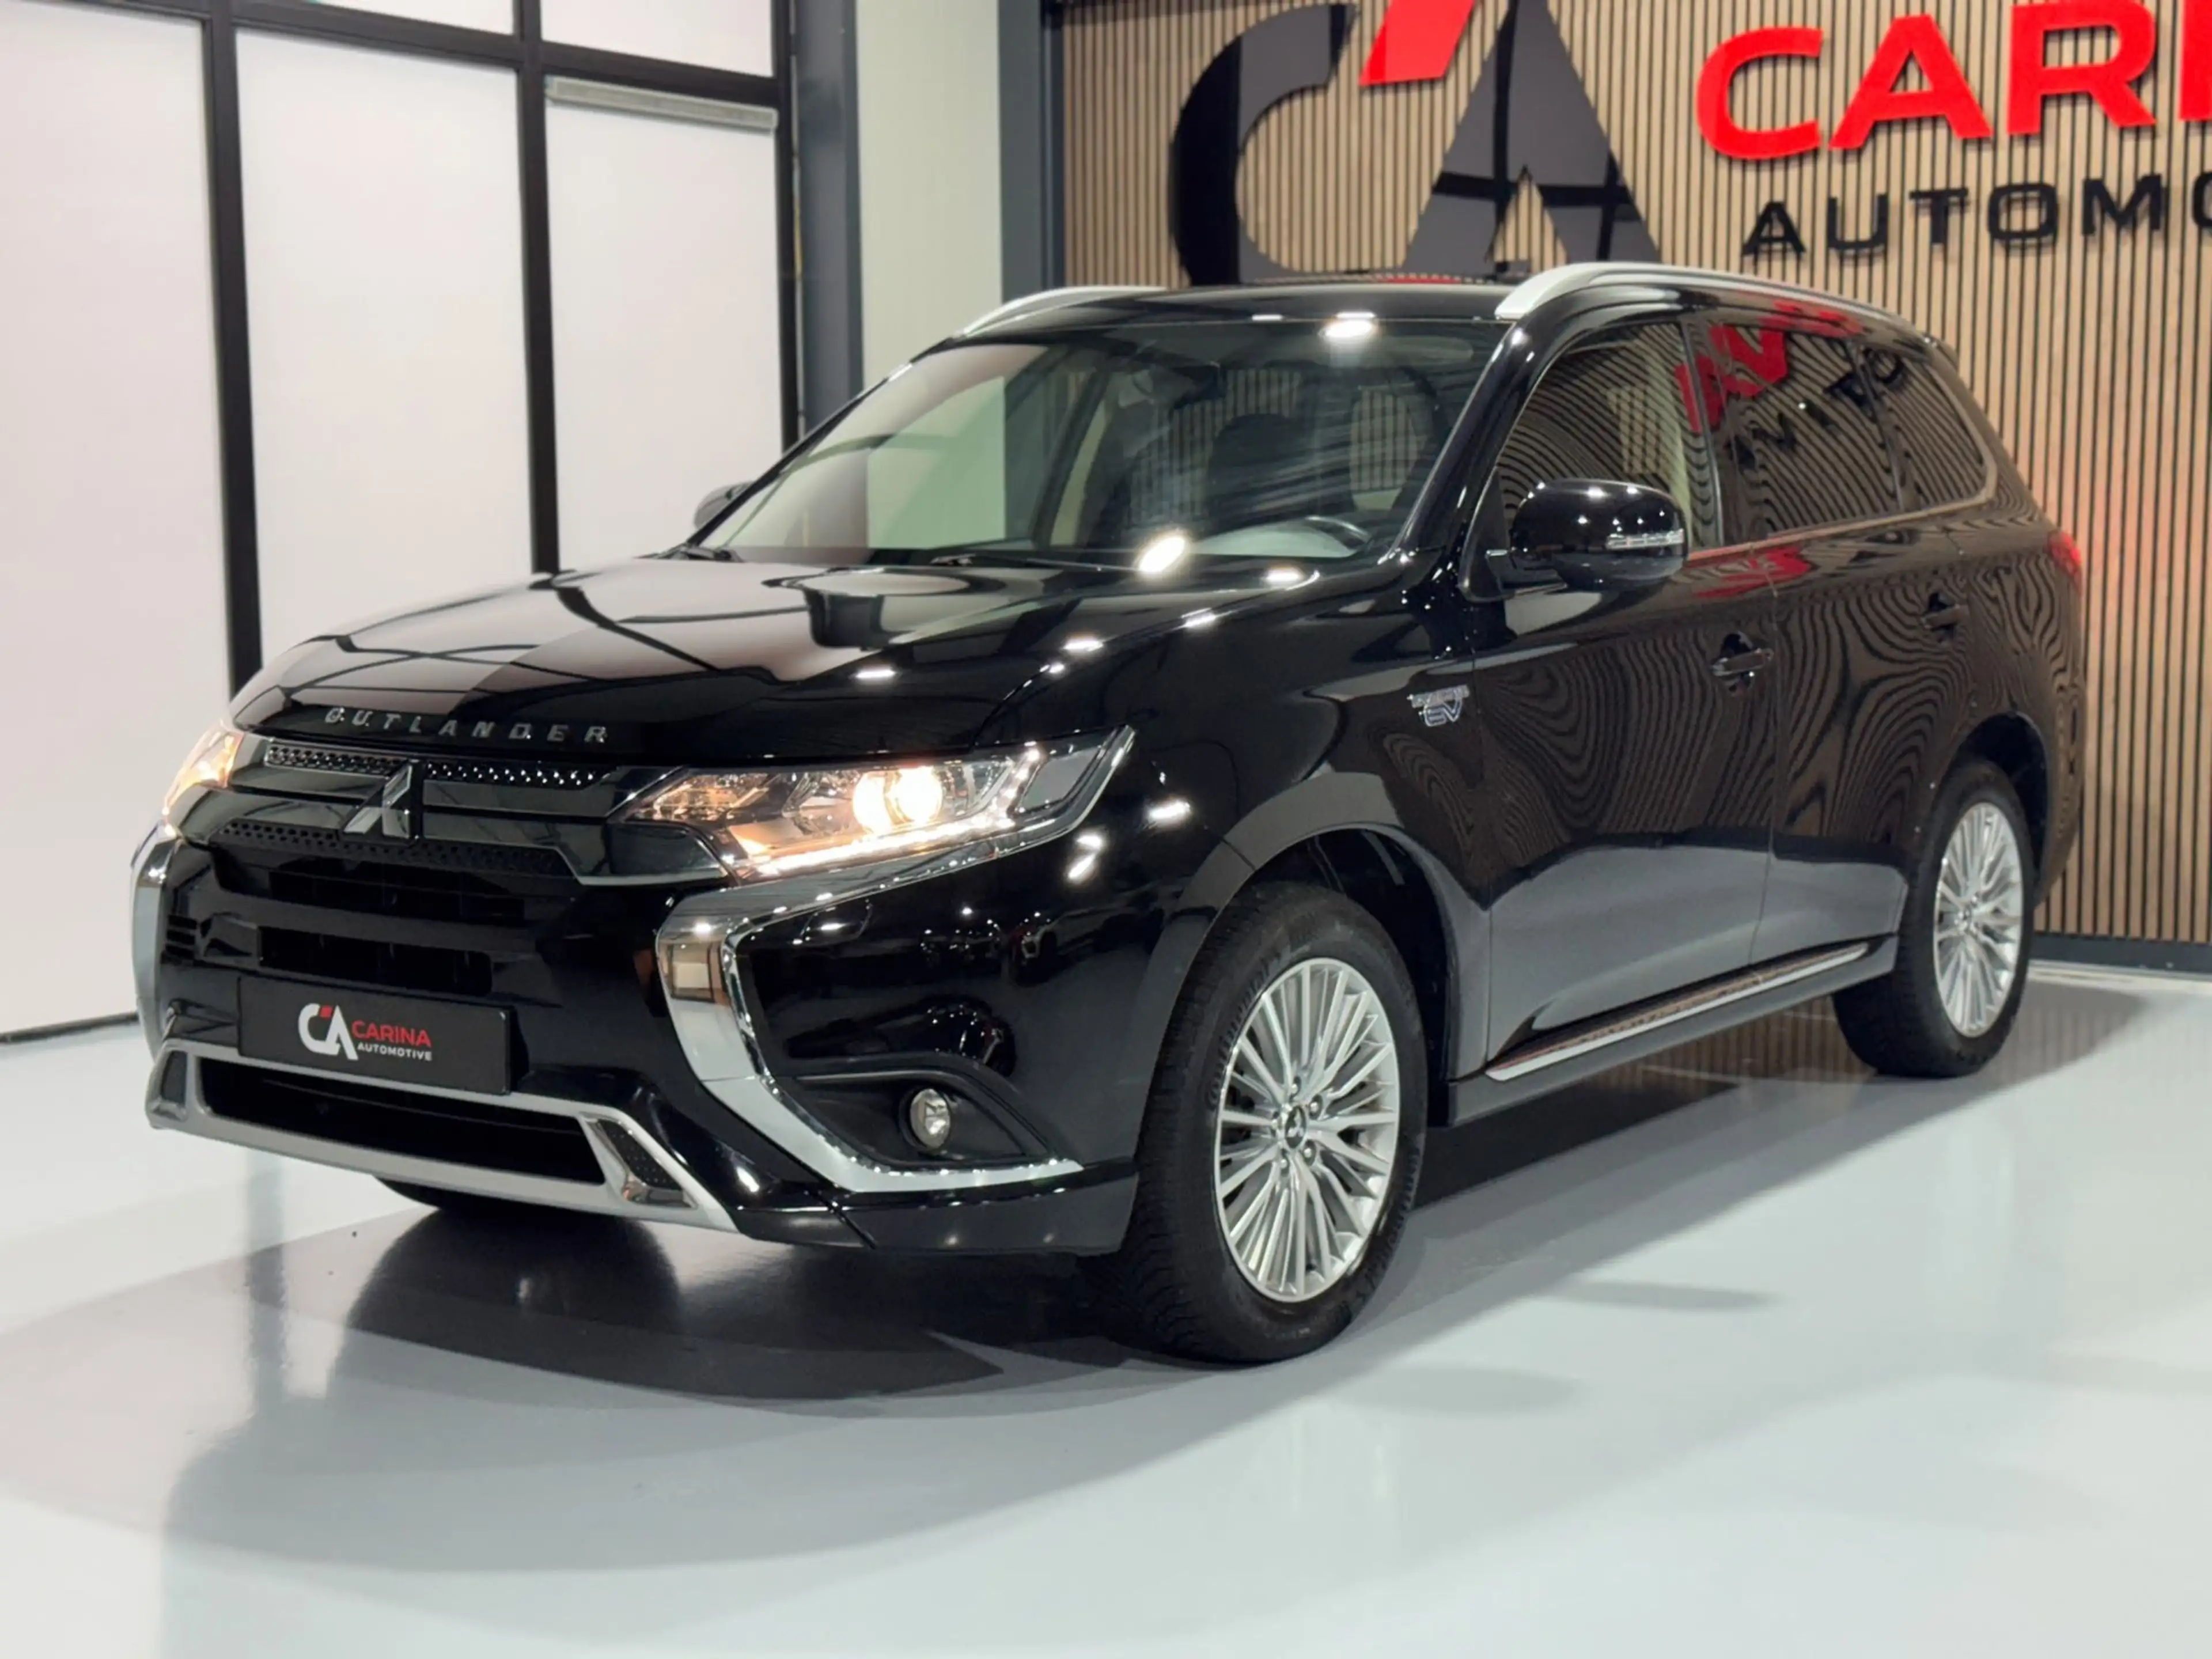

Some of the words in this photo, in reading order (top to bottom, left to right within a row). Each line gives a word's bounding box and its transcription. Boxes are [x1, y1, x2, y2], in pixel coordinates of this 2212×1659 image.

[1741, 172, 2212, 256] AUTOM
[324, 707, 609, 744] OUTLANDER
[351, 1019, 432, 1048] CARINA
[357, 1041, 433, 1061] AUTOMOTIVE
